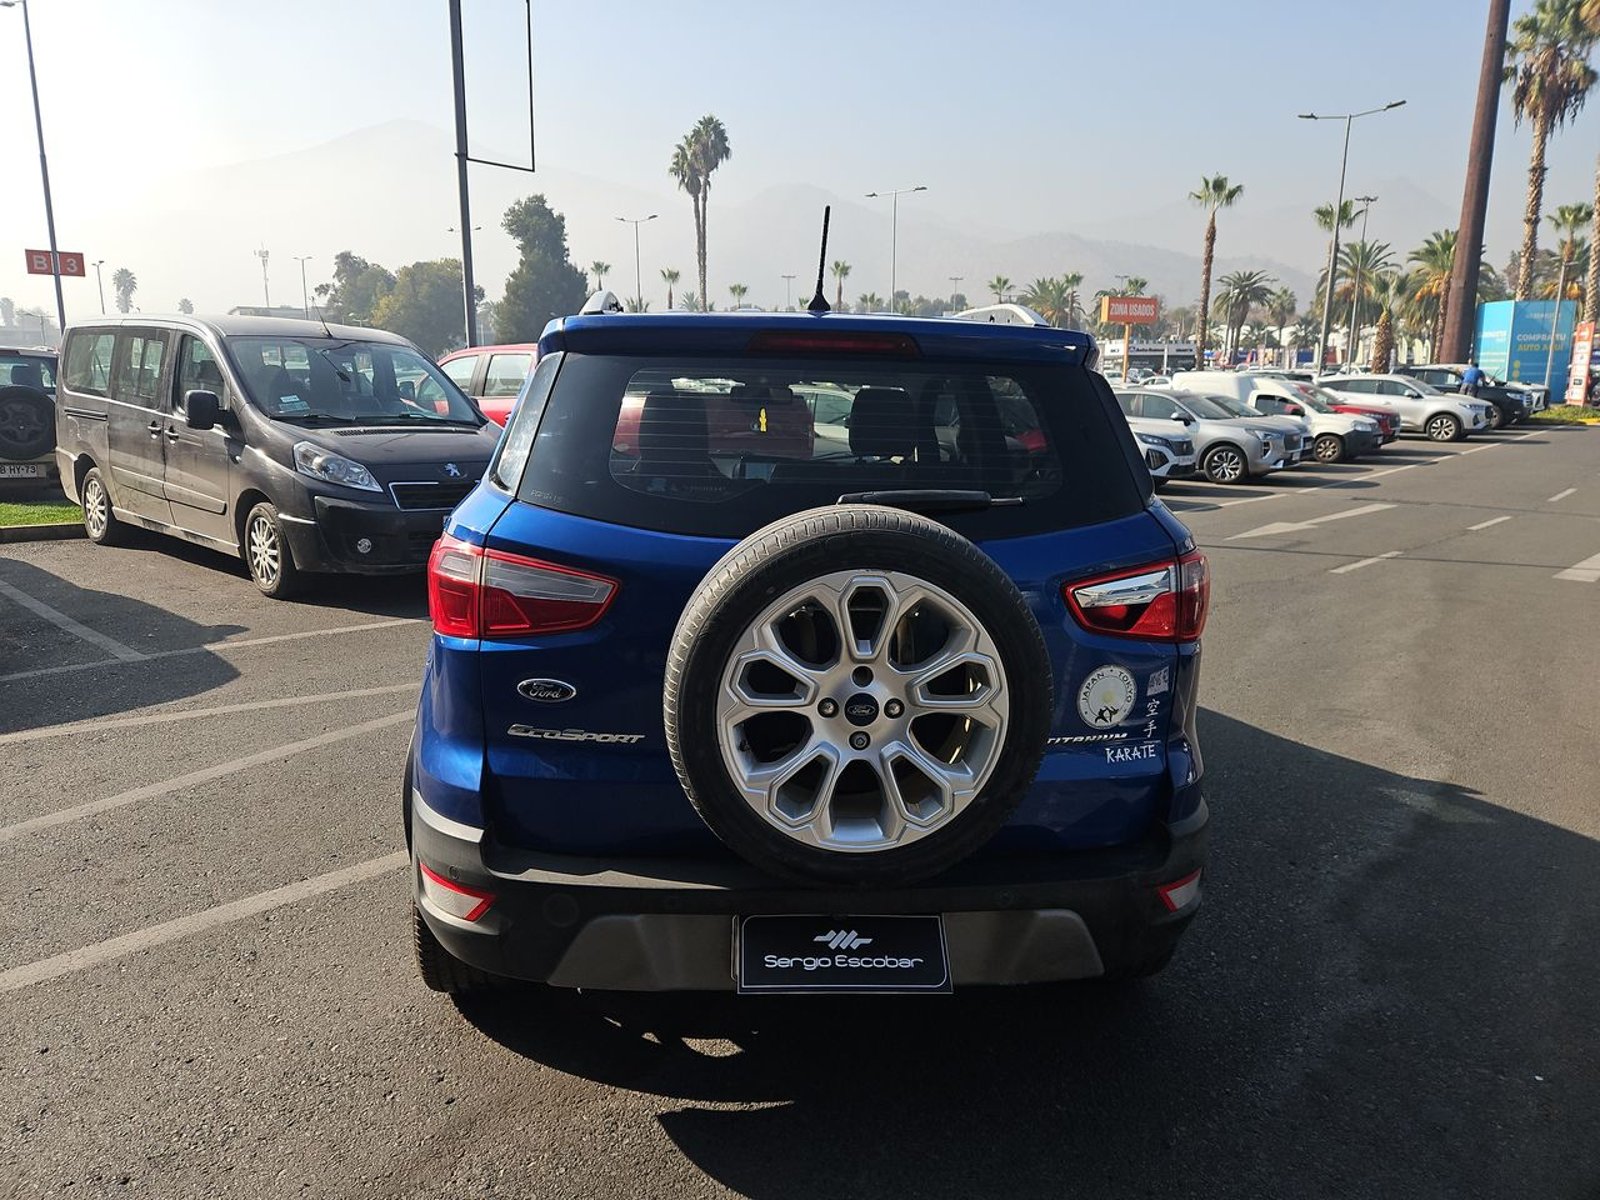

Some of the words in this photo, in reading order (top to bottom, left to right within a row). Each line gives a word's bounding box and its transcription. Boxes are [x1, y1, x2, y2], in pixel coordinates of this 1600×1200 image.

[33, 255, 48, 271] B
[66, 257, 78, 273] 3
[1110, 303, 1128, 316] ZONA
[1129, 303, 1155, 317] USADOS
[1081, 672, 1105, 702] JAPAN
[1118, 671, 1133, 703] TOKYO
[1105, 744, 1156, 763] KARATE
[764, 954, 832, 971] Sergio
[834, 954, 924, 970] Escobar
